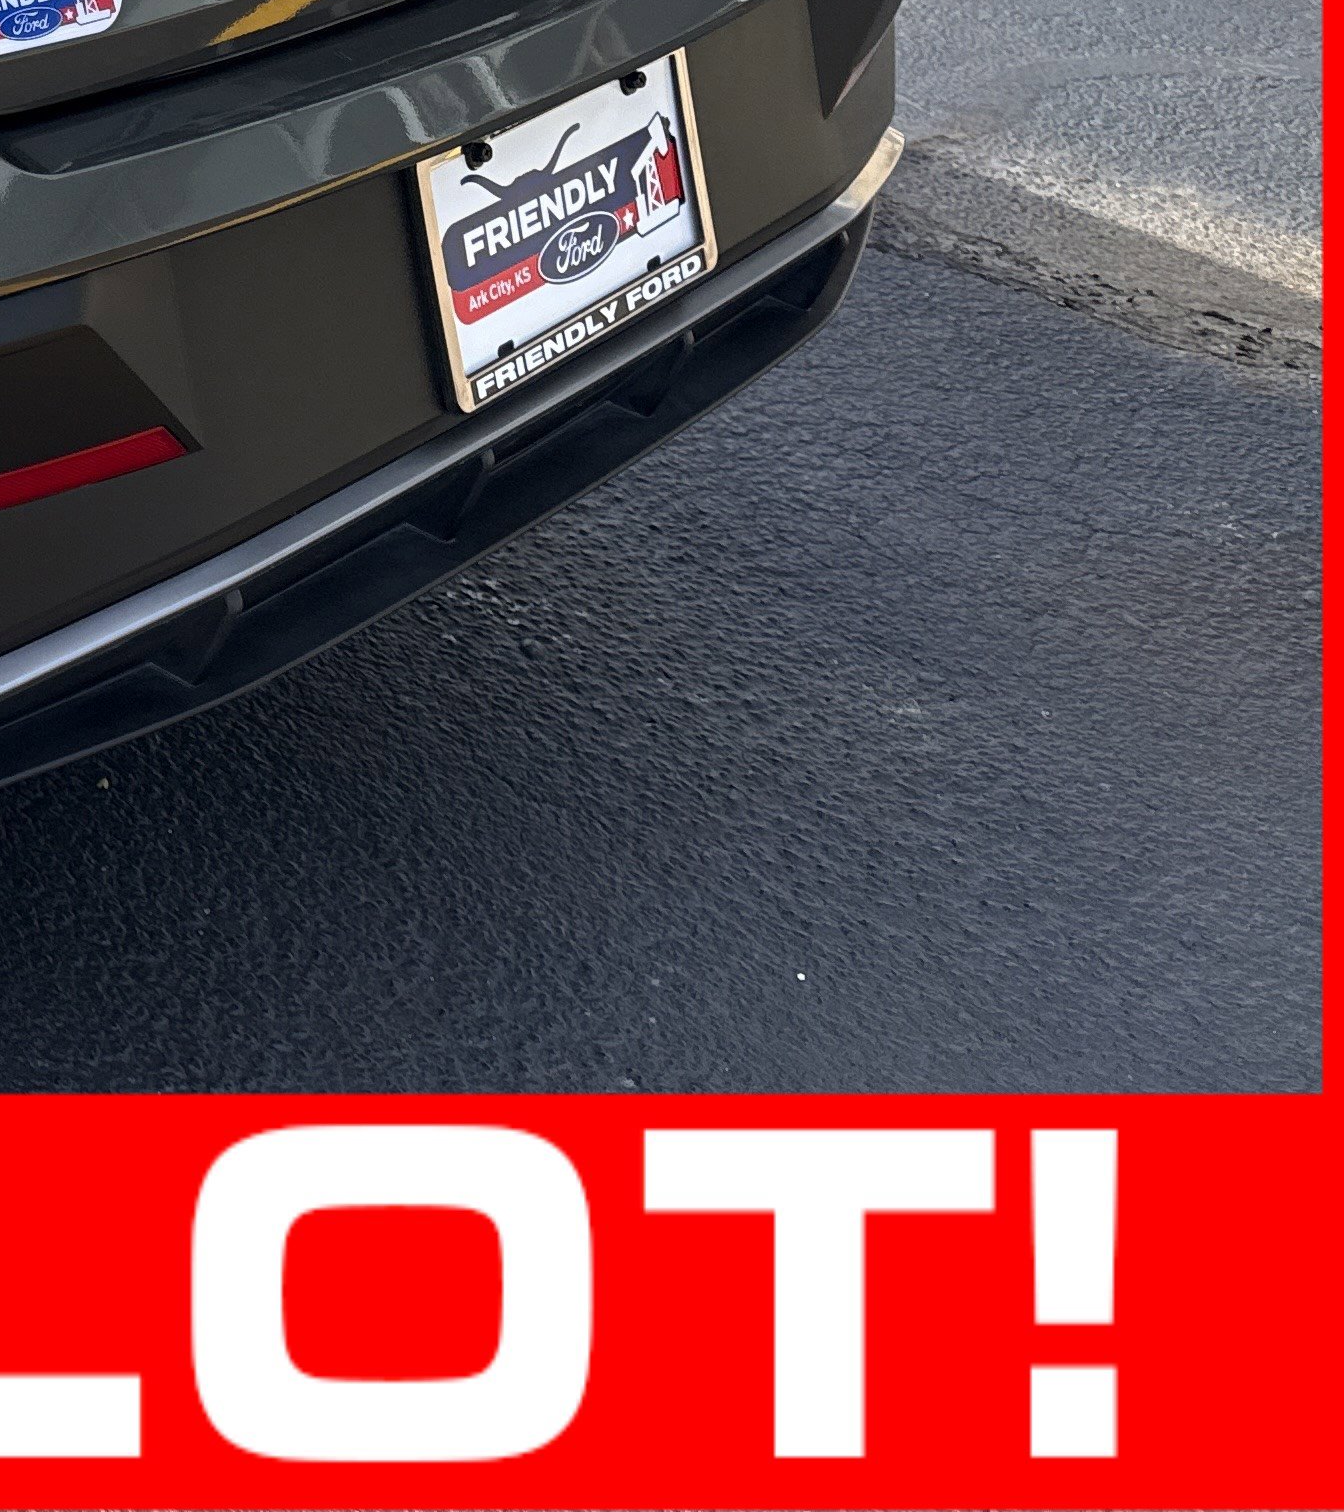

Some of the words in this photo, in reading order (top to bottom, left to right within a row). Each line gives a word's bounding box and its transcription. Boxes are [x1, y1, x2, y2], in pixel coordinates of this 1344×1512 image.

[13, 11, 50, 35] Ford
[462, 157, 618, 268] FRIENDLY
[556, 222, 604, 274] Ford
[468, 290, 489, 313] Ark
[489, 277, 515, 301] City,
[514, 269, 532, 288] KS
[475, 301, 620, 400] FRIENDLY
[625, 254, 702, 312] FORD
